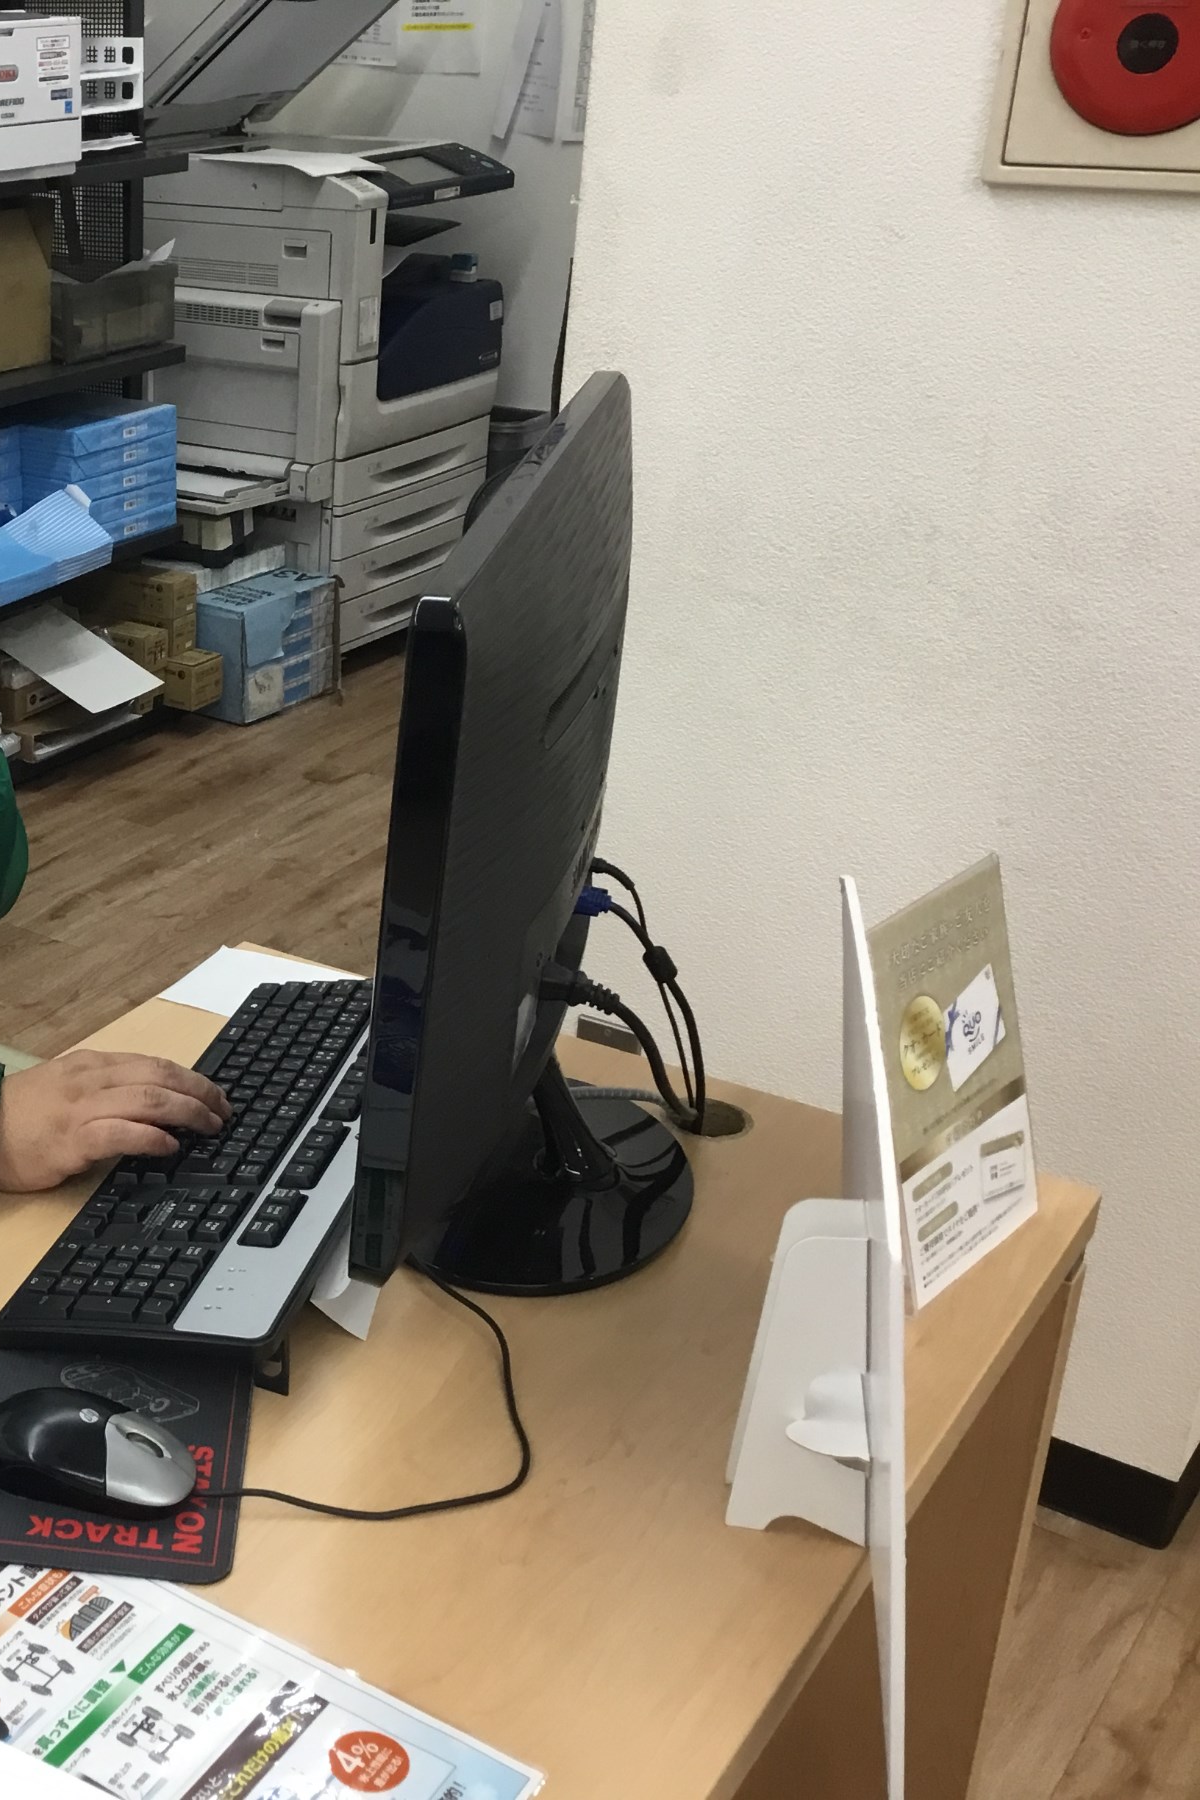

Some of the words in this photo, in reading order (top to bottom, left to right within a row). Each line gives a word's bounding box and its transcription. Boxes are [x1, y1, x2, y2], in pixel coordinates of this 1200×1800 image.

[962, 1010, 983, 1038] QUO
[26, 1515, 164, 1551] TRACK
[171, 1511, 207, 1554] ON
[335, 1739, 380, 1776] 4%
